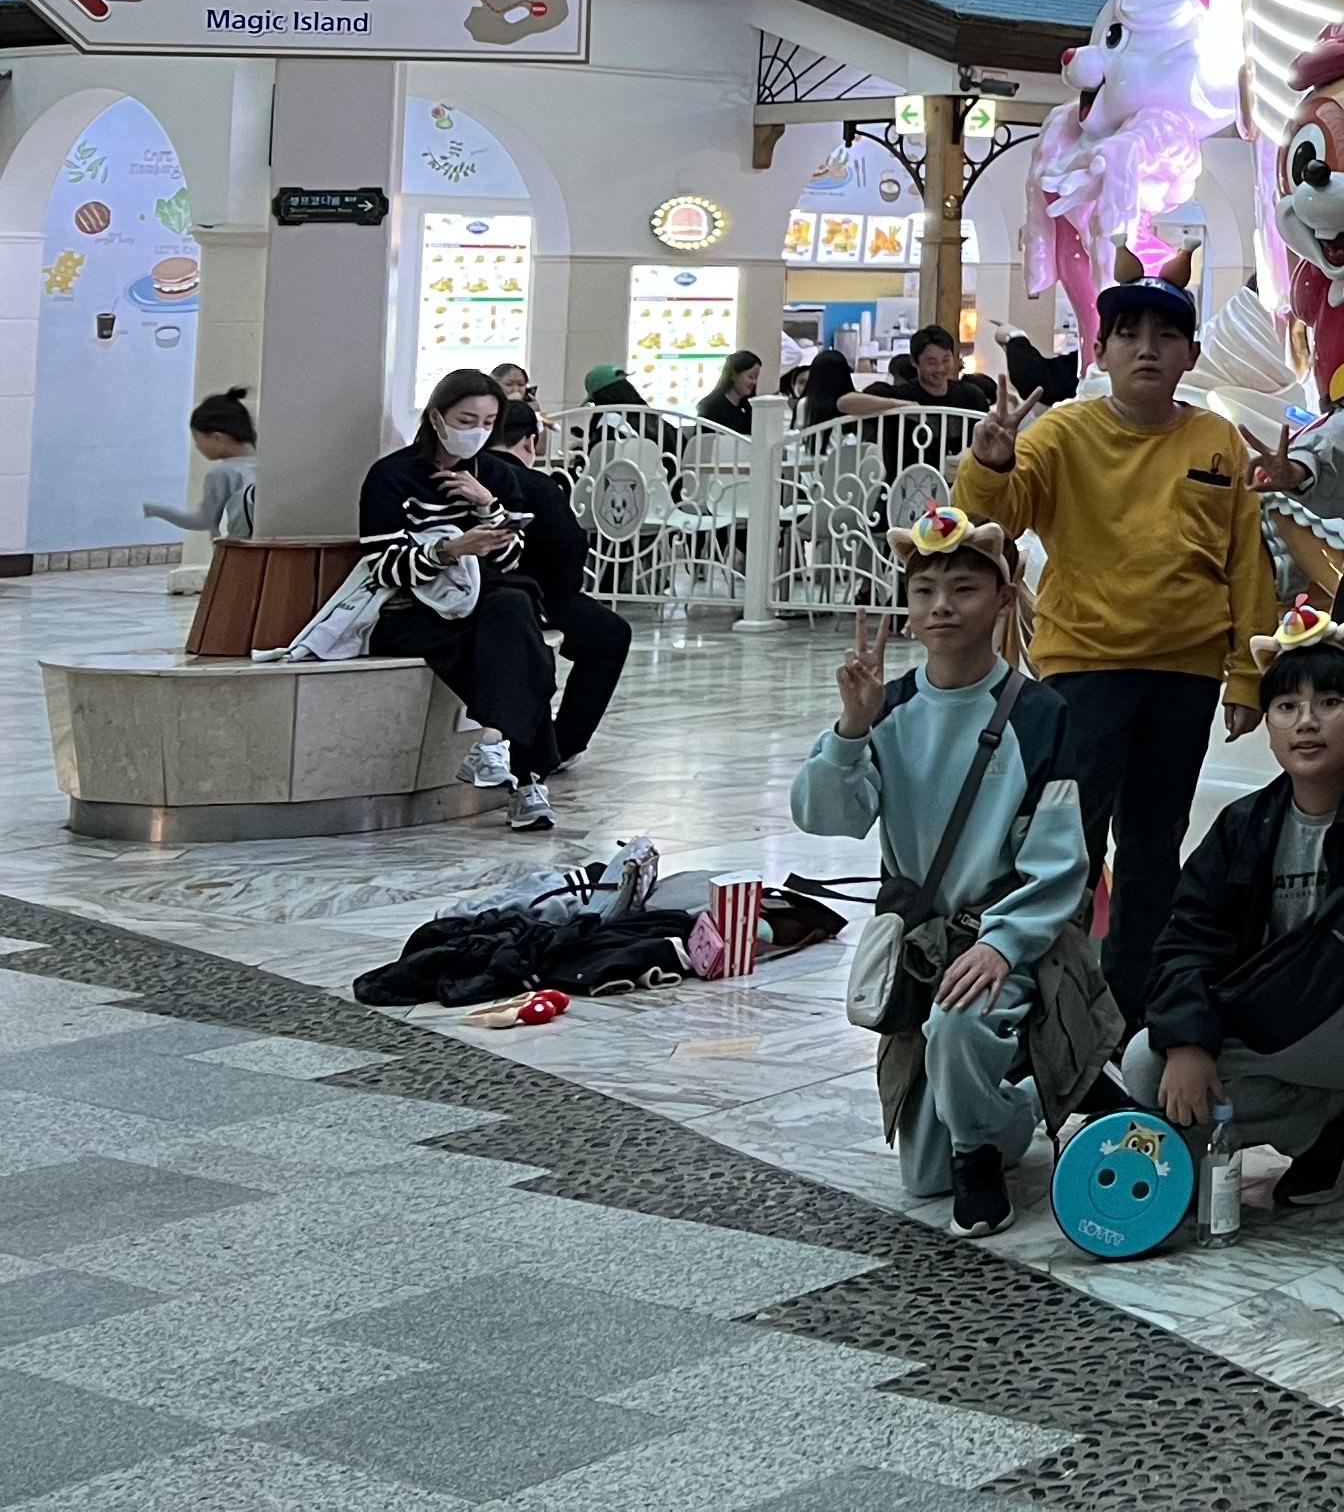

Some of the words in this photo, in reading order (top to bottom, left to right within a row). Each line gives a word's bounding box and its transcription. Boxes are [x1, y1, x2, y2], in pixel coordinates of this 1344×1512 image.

[206, 8, 284, 36] Magic
[293, 10, 370, 33] Island
[1077, 1218, 1126, 1247] LOTTY
